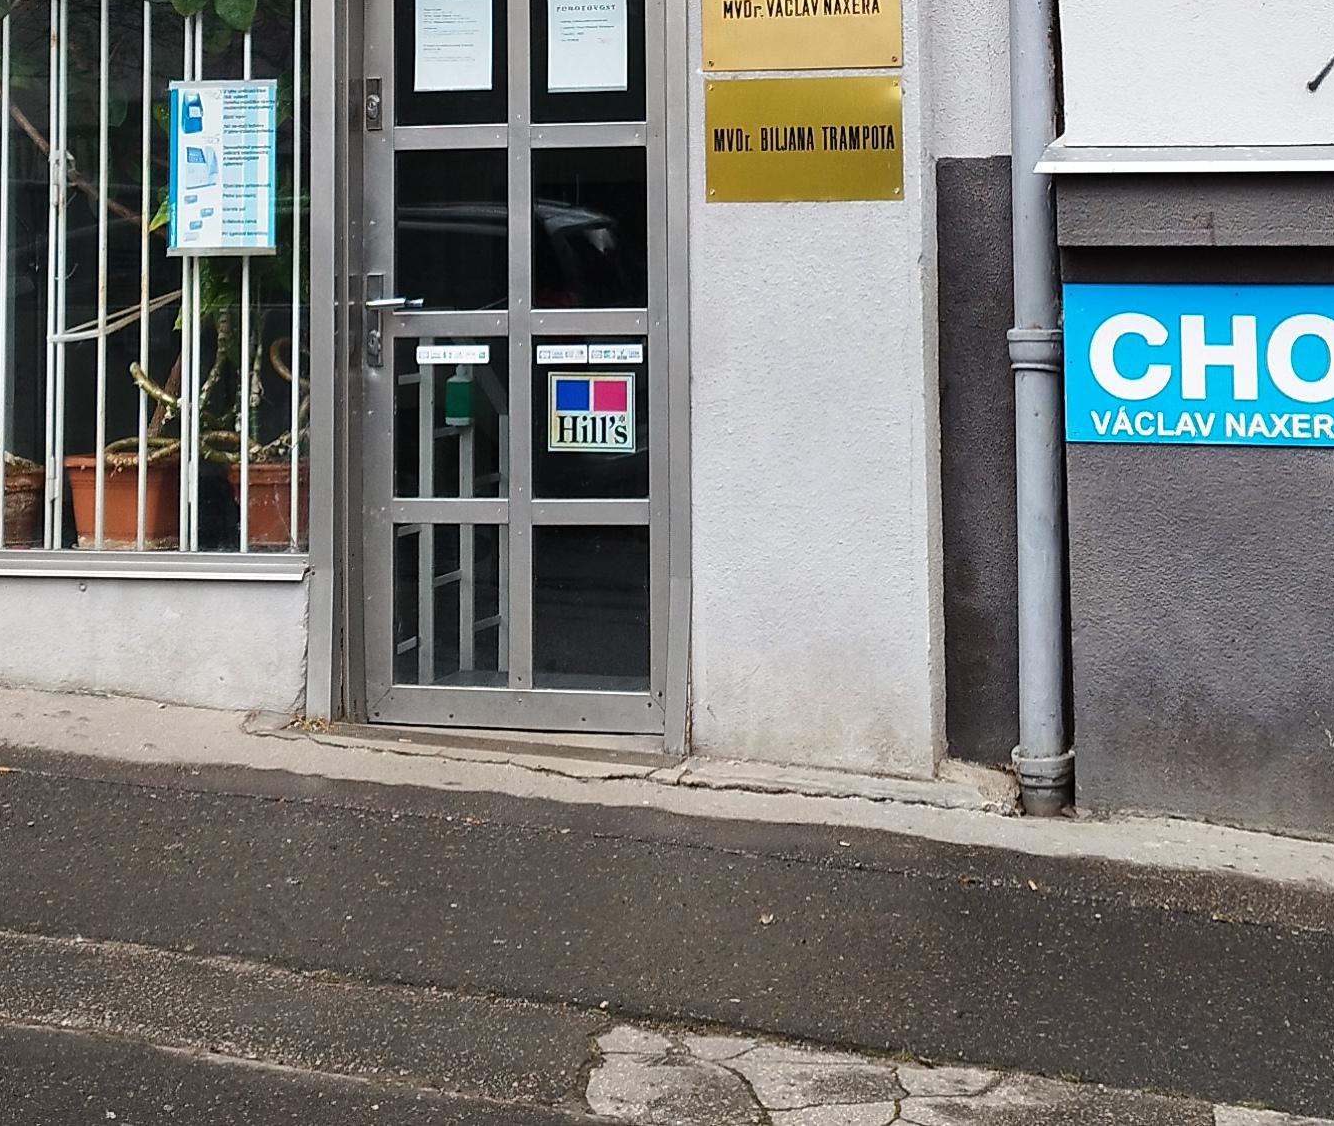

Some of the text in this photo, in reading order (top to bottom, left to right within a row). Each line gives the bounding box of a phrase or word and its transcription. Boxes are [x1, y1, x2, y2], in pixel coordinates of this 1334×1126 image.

[723, 0, 764, 19] MVDr.
[713, 124, 896, 152] MVDr. BILJANA TRAMPOTA
[1090, 406, 1216, 438] VÁCLAV
